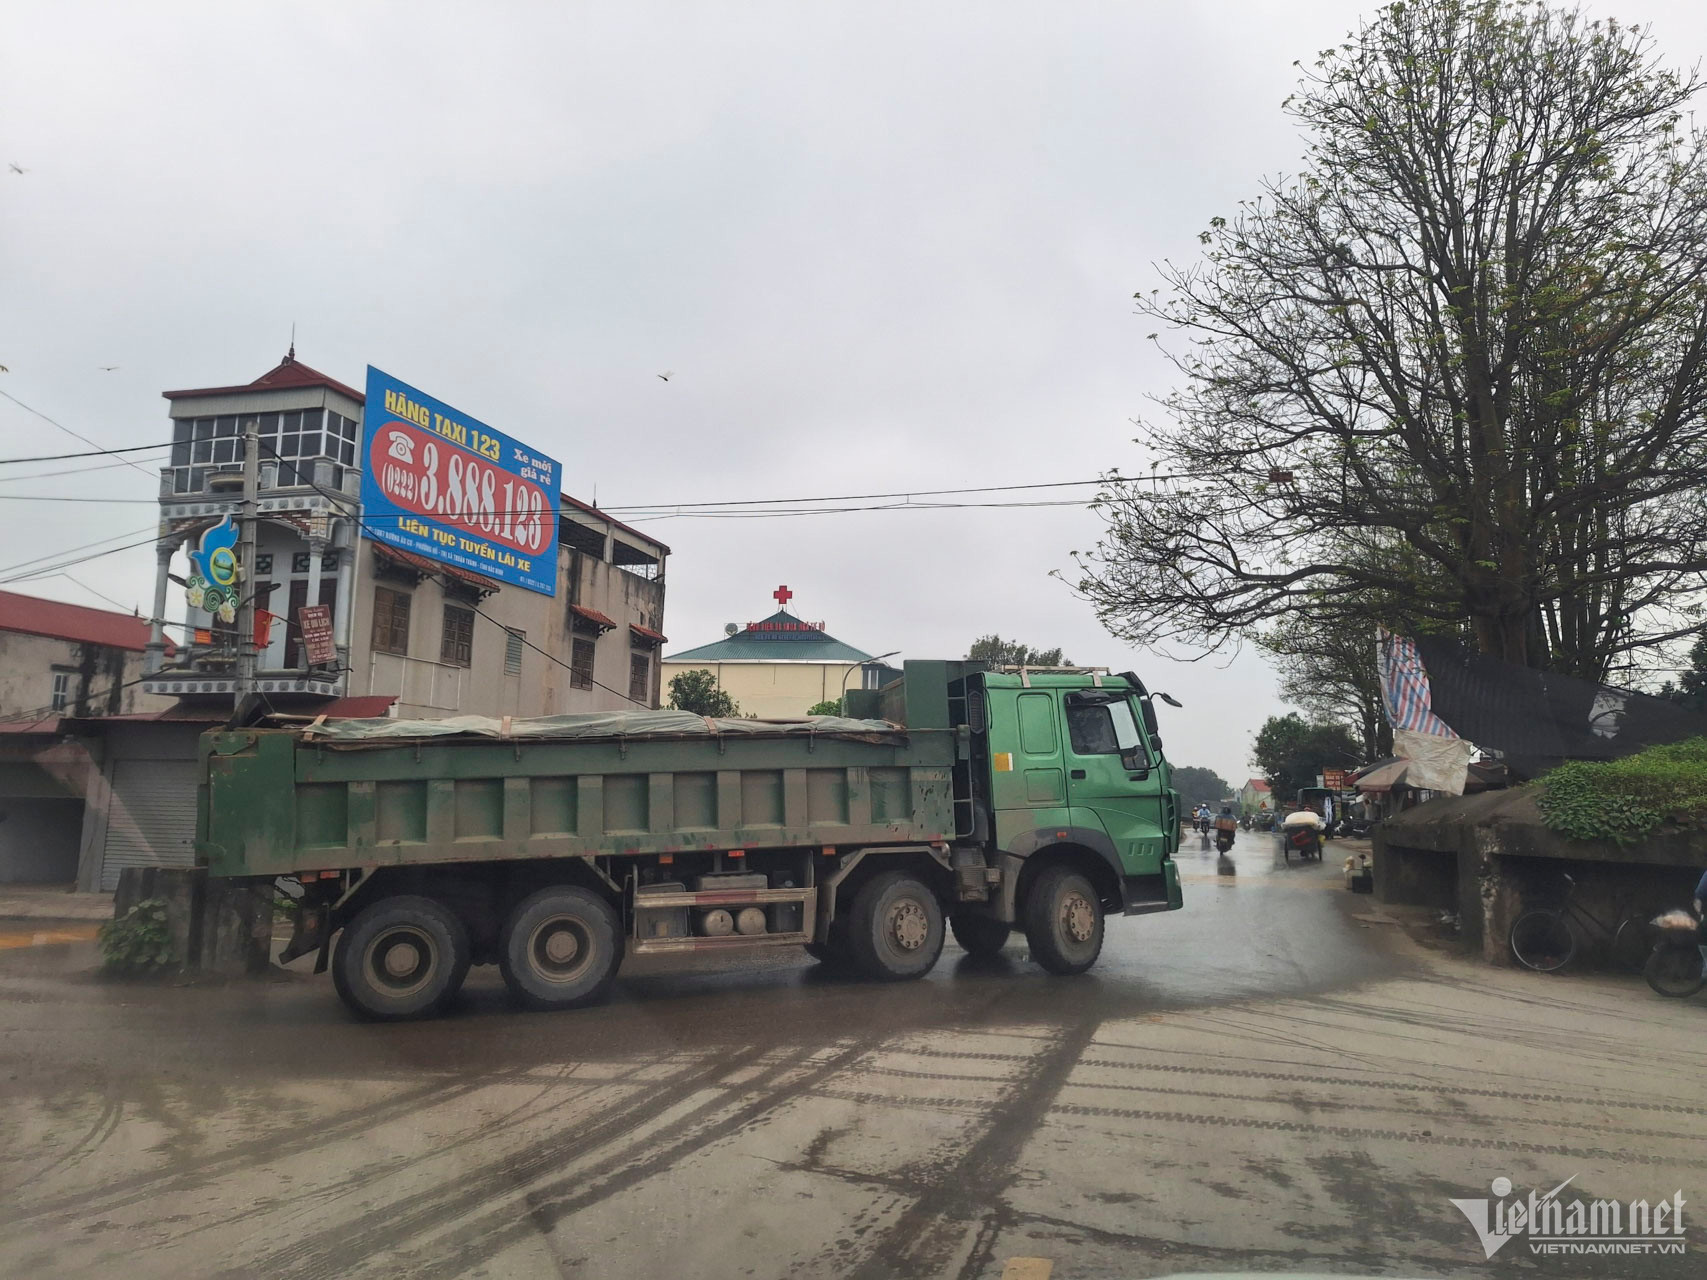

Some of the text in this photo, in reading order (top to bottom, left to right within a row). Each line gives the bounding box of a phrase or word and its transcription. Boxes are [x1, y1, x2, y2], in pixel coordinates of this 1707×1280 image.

[385, 389, 500, 460] HÃNG TAXI 123
[514, 448, 552, 473] Xe mới
[520, 466, 537, 480] giá
[382, 442, 542, 550] (0222) 3.888.123
[398, 516, 531, 572] LIÊN TỤC TUYỂN LÁI XE
